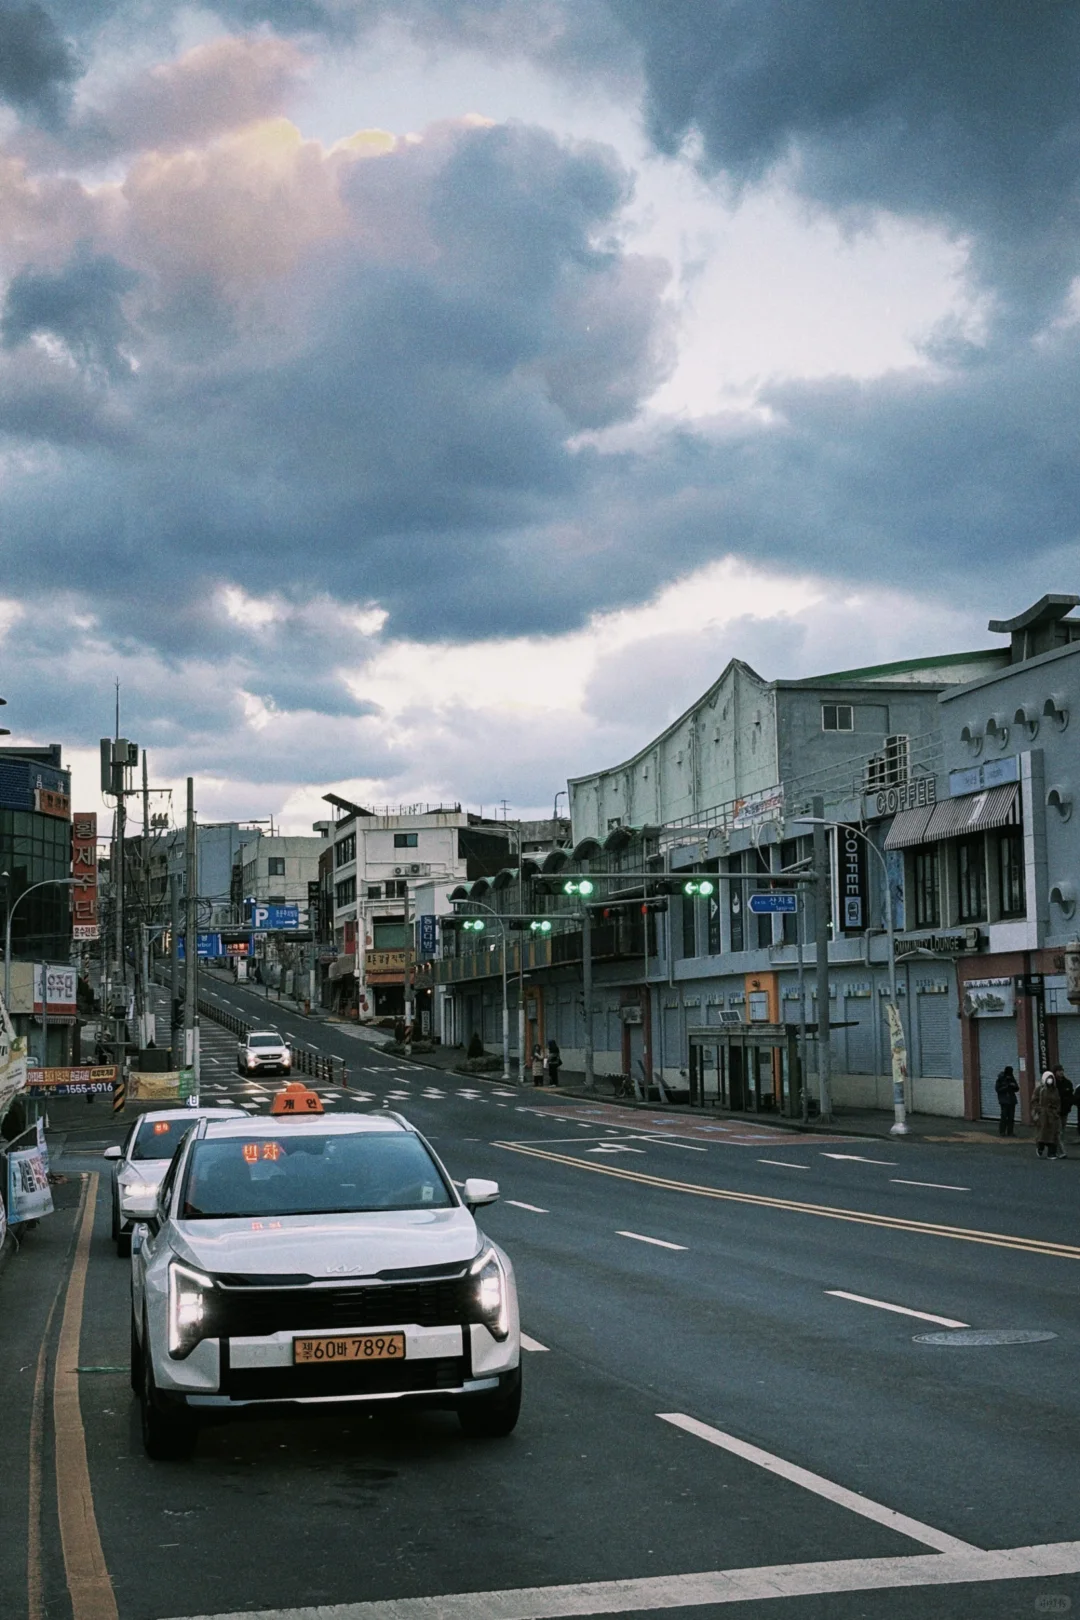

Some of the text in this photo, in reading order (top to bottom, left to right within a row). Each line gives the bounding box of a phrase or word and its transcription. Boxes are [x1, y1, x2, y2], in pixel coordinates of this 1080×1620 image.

[876, 777, 936, 816] COFFEE
[75, 820, 96, 919] 황제주단
[844, 828, 860, 895] COFFEE
[768, 896, 793, 906] 산지로
[255, 908, 269, 927] P
[74, 926, 97, 937] 혼수전문
[894, 934, 959, 956] OMMUNITY LOUNGE
[27, 1071, 44, 1082] 아파트
[65, 1082, 113, 1094] 1555-5916
[244, 1143, 279, 1161] 빈차
[351, 1338, 397, 1357] 7896
